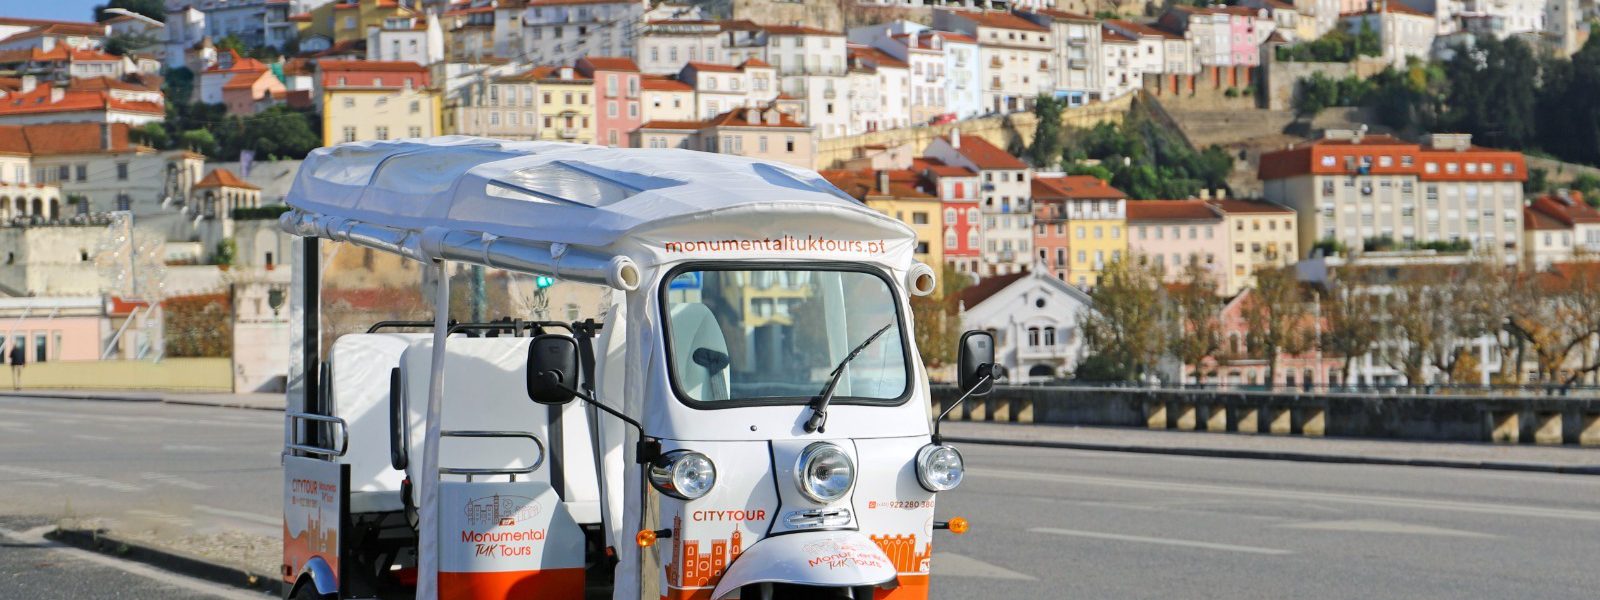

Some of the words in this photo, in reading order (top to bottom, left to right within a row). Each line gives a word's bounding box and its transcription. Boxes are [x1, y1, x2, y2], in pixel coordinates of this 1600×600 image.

[665, 234, 886, 254] monumentaltuktours.pt
[461, 528, 545, 543] Monumental
[475, 543, 498, 559] TUK
[499, 544, 532, 557] Tours
